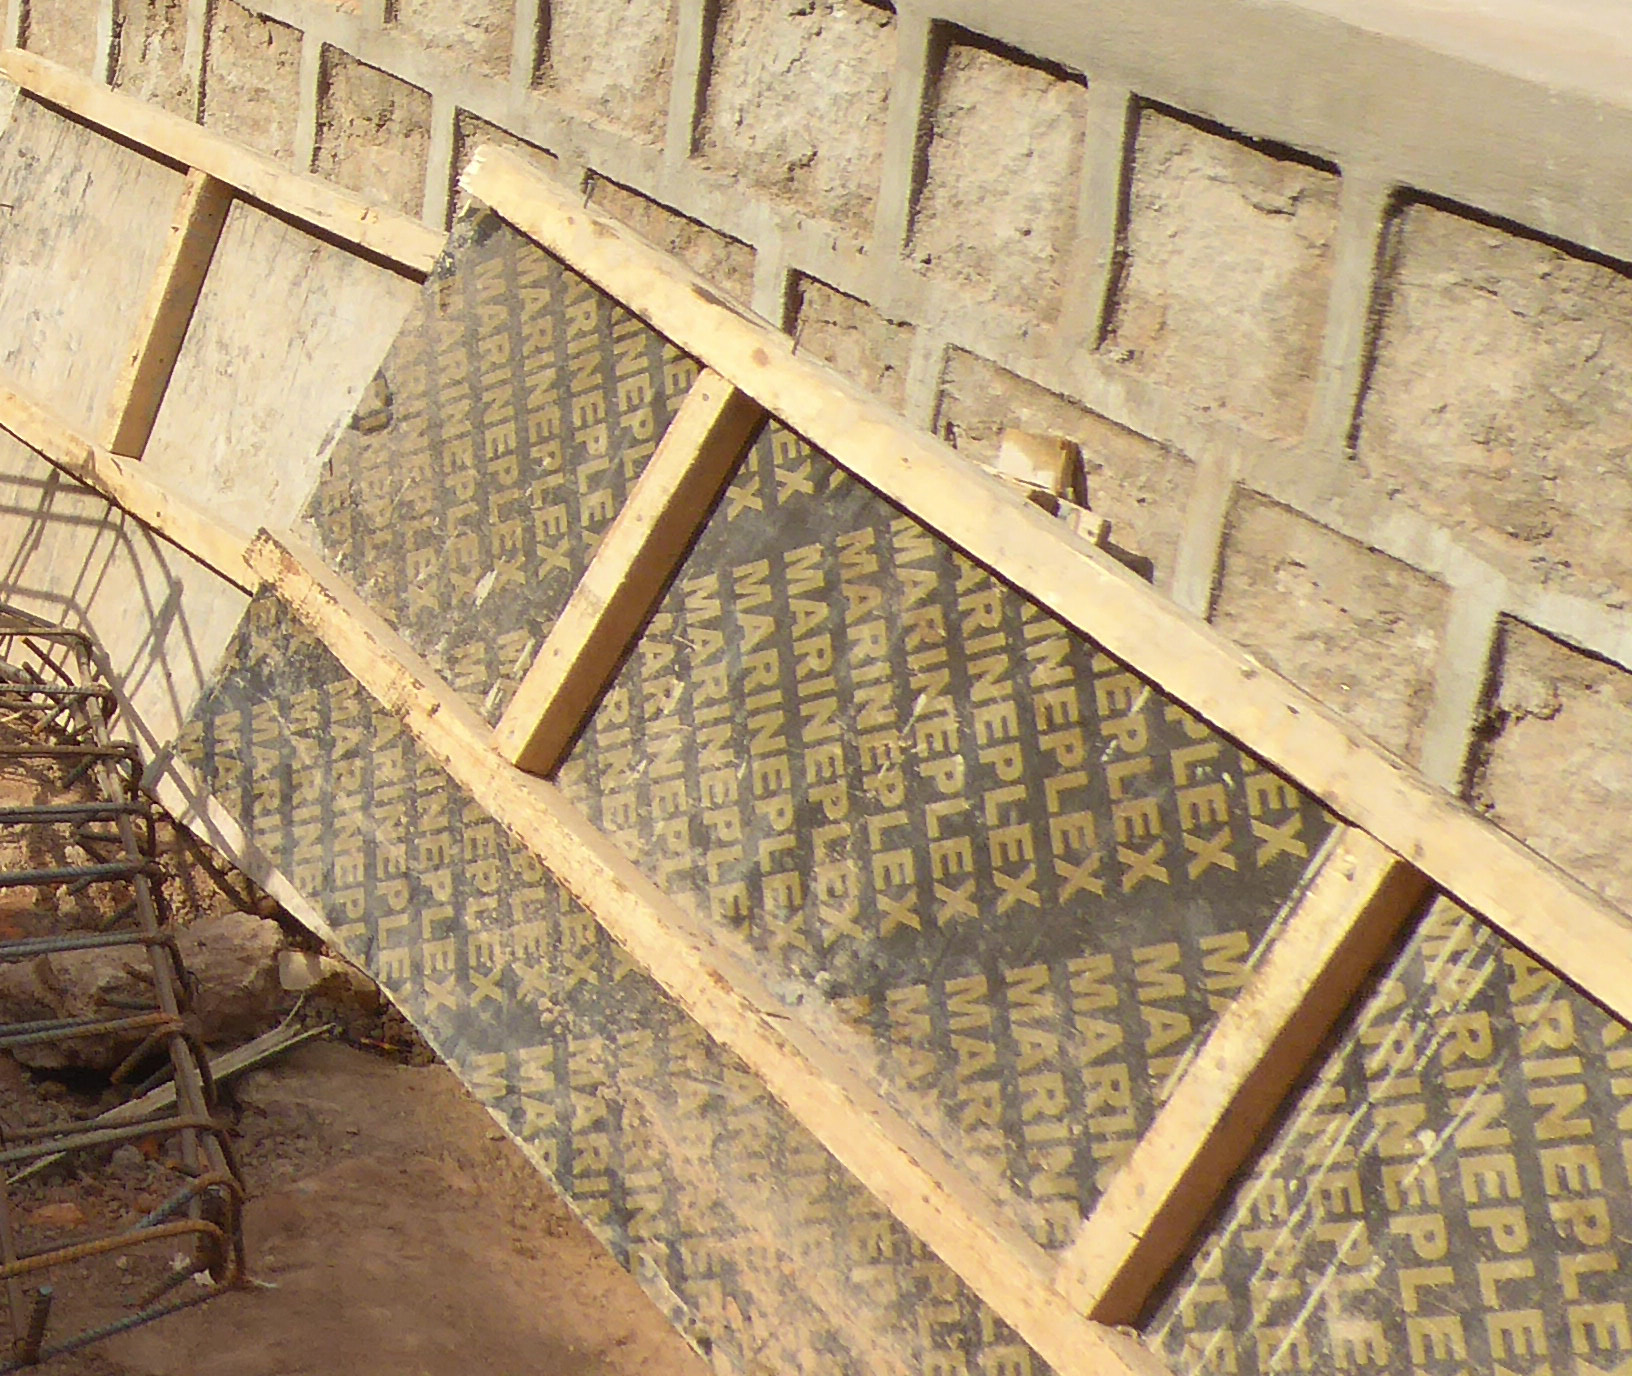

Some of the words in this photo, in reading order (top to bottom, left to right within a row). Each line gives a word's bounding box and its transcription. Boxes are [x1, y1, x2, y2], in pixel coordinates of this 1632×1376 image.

[474, 257, 527, 591] MARINEPLEX
[683, 572, 750, 932] MARINEPLE
[784, 543, 866, 948] MARINEPLEX
[836, 527, 923, 939] MARINEPLEX
[890, 516, 980, 927] MARINEPLEX
[953, 551, 1043, 915] ARINEPLEX
[1503, 946, 1631, 1360] ARINEPLE
